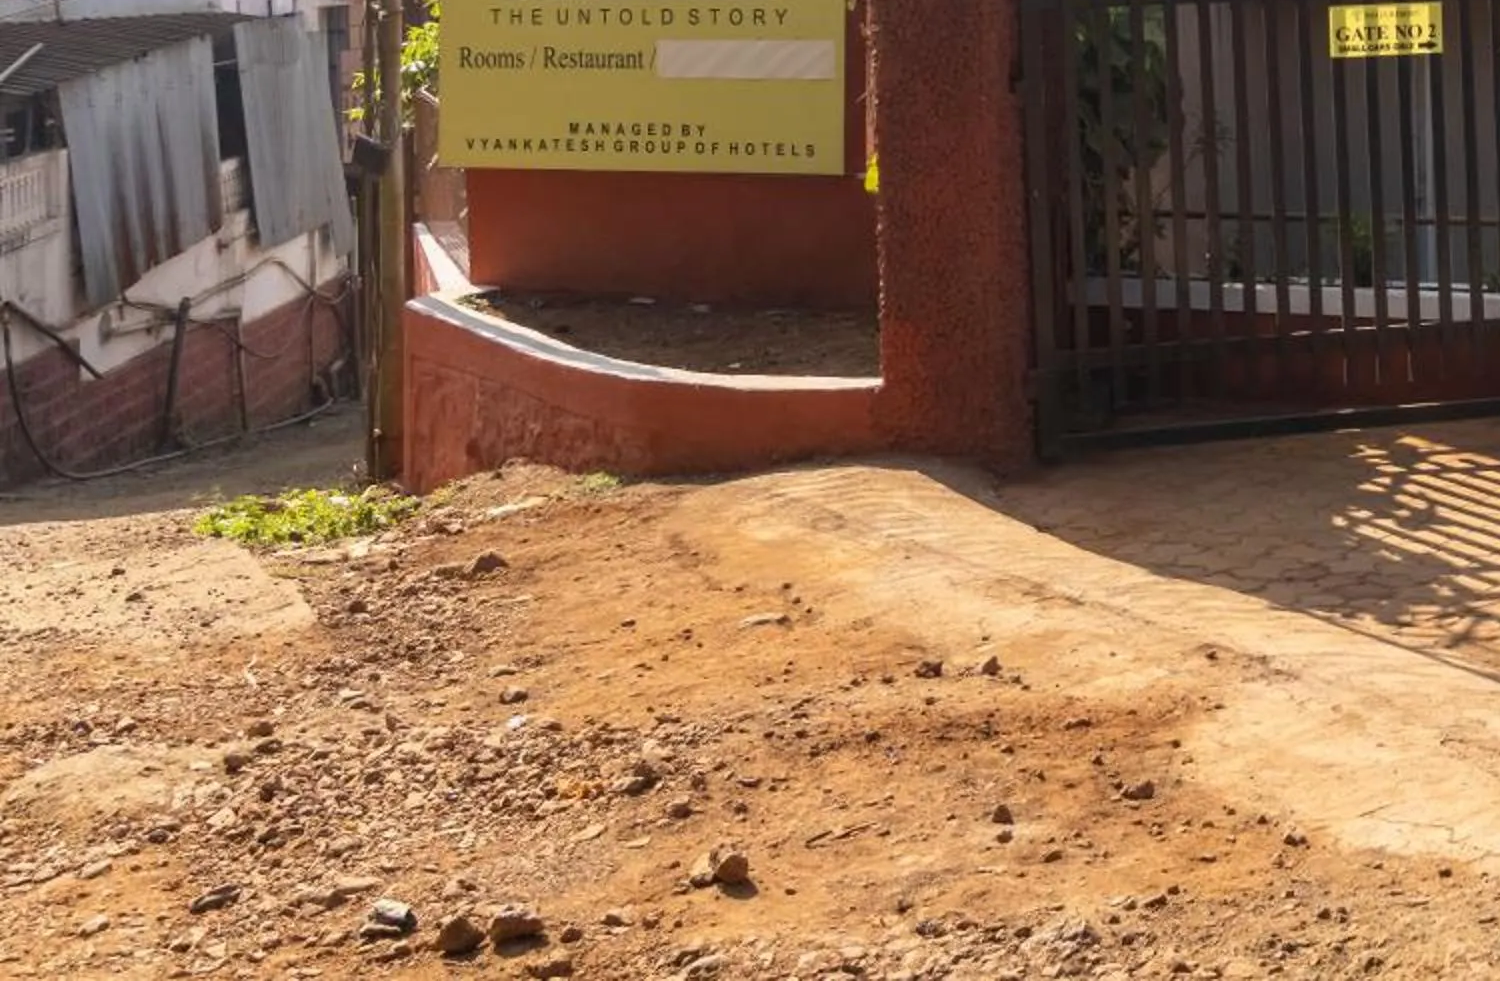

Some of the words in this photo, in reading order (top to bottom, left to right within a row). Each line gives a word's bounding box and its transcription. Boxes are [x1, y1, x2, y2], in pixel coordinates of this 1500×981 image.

[489, 8, 543, 25] THE
[556, 8, 675, 26] UNTOLD
[687, 8, 790, 26] STORY
[1335, 25, 1389, 42] GATE
[1395, 24, 1423, 39] NO
[1428, 23, 1438, 38] 2
[459, 46, 526, 70] Rooms
[543, 46, 645, 70] Restaurant
[568, 122, 672, 137] MANAGED
[680, 124, 707, 138] BY
[465, 138, 606, 153] VYANKATESH
[613, 139, 687, 155] GROUP
[694, 141, 720, 155] OF
[728, 142, 816, 159] HOTELS
